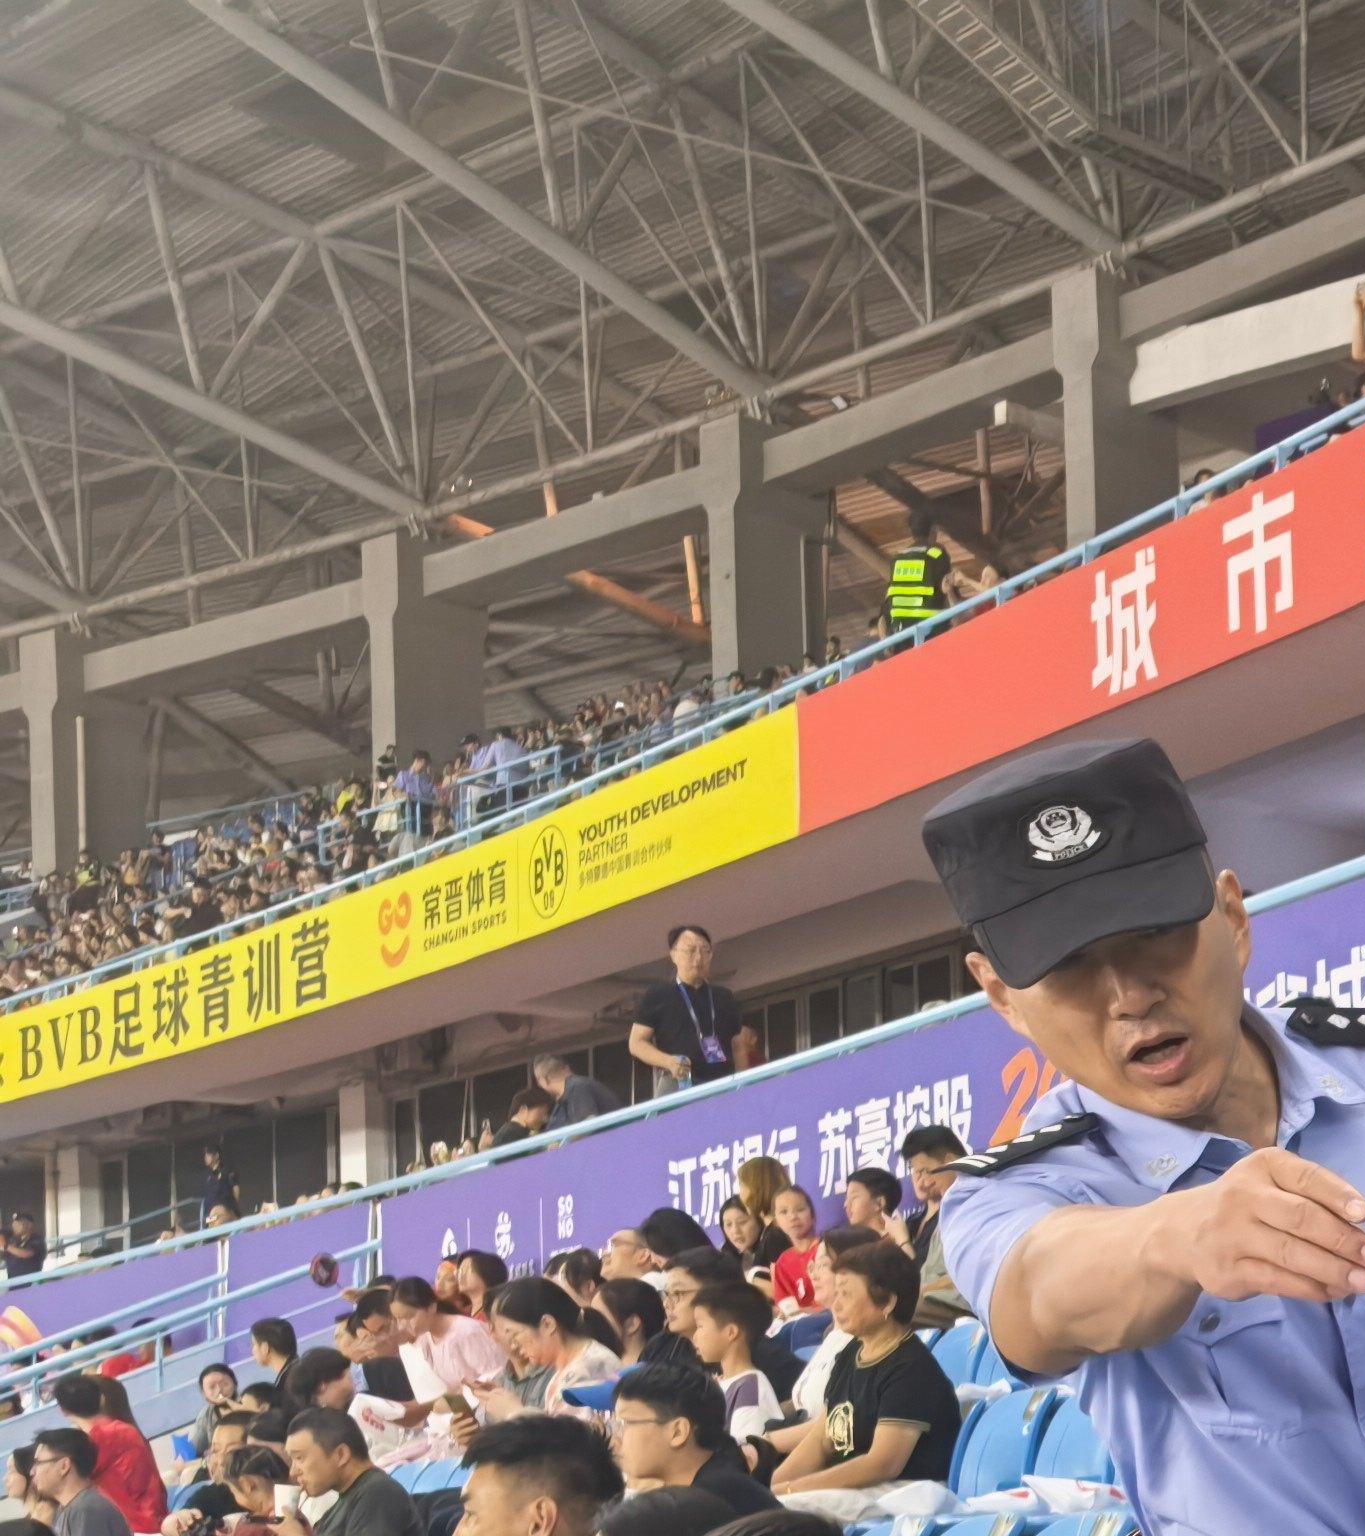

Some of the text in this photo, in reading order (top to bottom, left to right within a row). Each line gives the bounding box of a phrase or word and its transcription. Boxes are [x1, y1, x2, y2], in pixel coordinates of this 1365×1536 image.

[578, 757, 749, 846] YOUTH DEVELOPMENT
[533, 833, 565, 896] BVB
[578, 832, 628, 868] PARTNER
[422, 859, 508, 932] 常晋体育
[423, 908, 508, 952] CHANGJIN SPORTS
